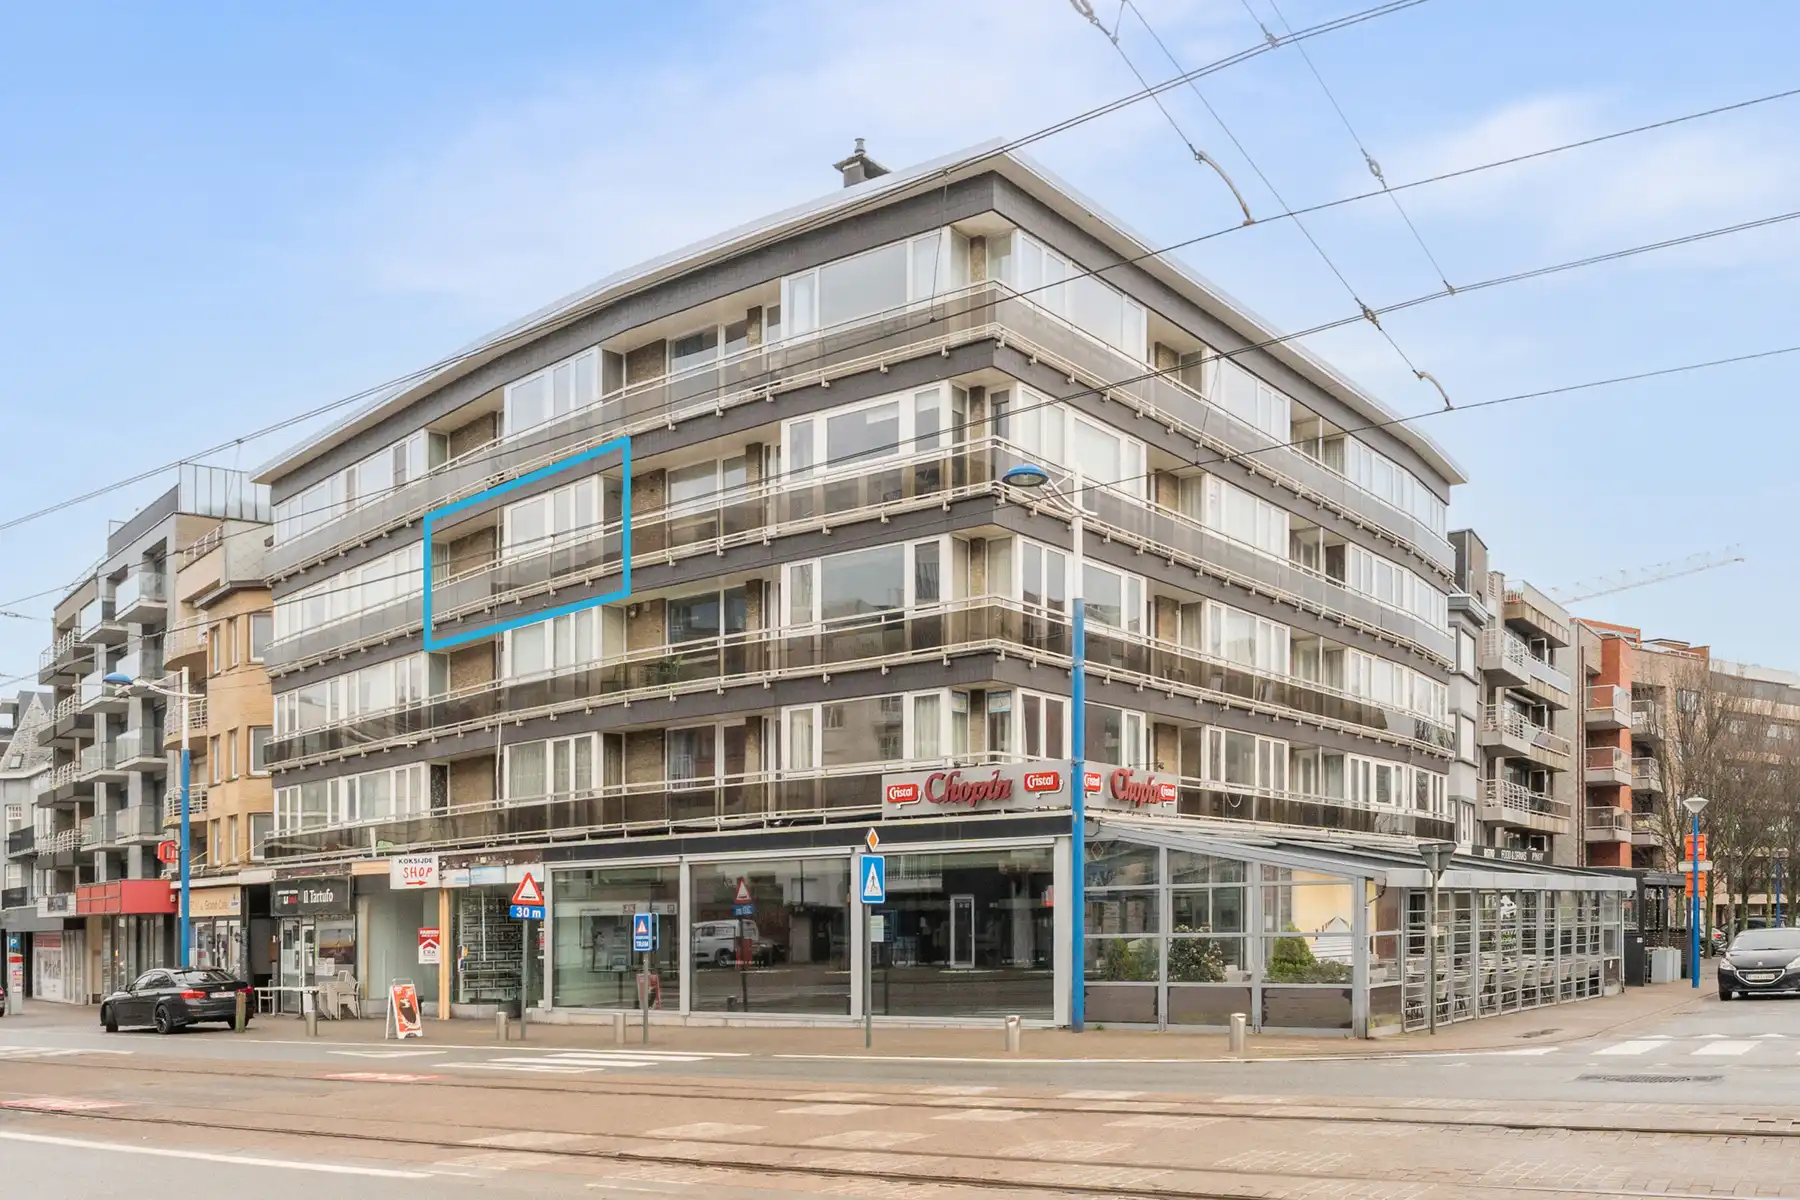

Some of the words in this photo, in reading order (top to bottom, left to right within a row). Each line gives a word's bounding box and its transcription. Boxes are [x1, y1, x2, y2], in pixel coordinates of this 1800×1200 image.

[1027, 773, 1054, 788] Cristal
[889, 786, 913, 800] Cristal
[924, 769, 1013, 808] Chopin
[403, 867, 433, 879] SHOP
[309, 888, 334, 903] Tartufo
[516, 907, 529, 918] 30
[532, 909, 541, 918] m
